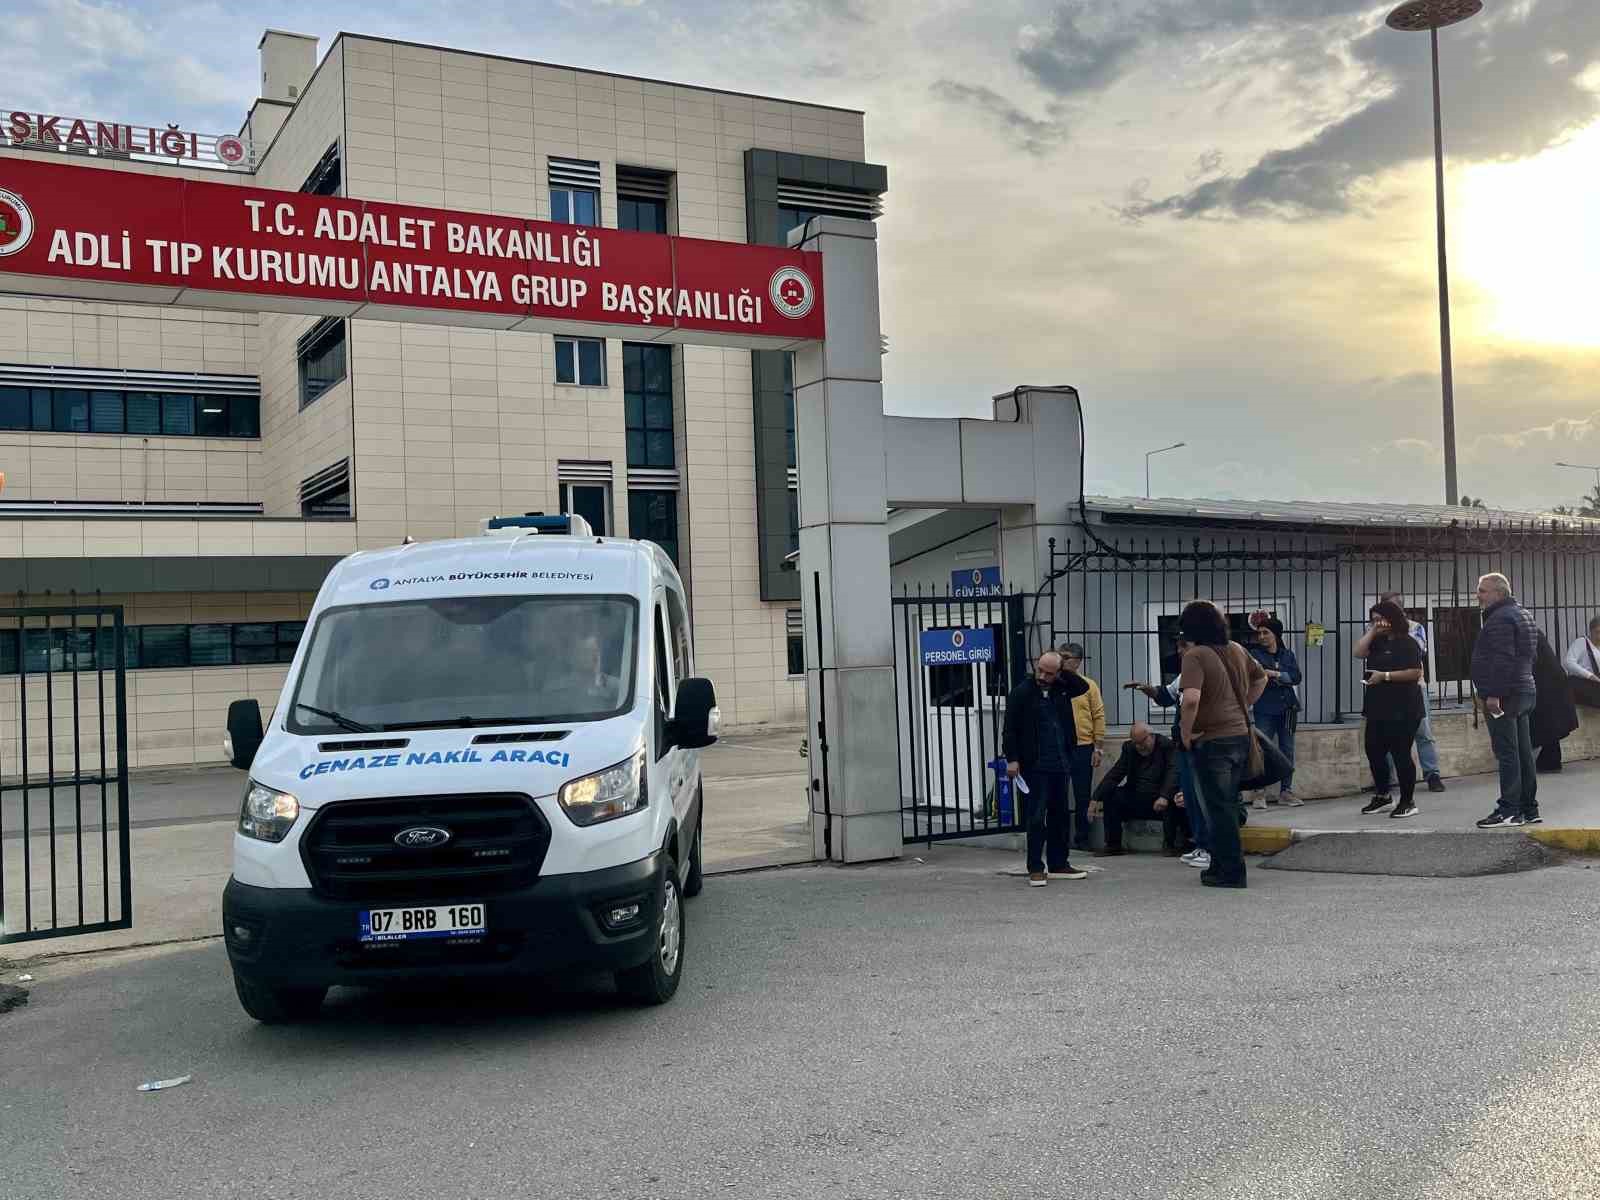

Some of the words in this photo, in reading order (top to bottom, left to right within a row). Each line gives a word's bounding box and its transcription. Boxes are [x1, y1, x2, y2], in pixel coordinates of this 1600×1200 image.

[0, 111, 197, 159] ŞKANLIĞI
[244, 199, 304, 236] T.C.
[314, 207, 436, 250] ADALET
[446, 221, 602, 268] BAKANLIĞI
[47, 229, 131, 271] ADLİ
[145, 238, 202, 275] TIP
[212, 246, 359, 290] KURUMU
[370, 259, 503, 303] ANTALYA
[511, 273, 588, 308] GRUP
[602, 280, 762, 324] BAŞKANLIĞI
[393, 575, 445, 586] ANTALYA
[924, 650, 968, 663] PERSONEL
[969, 646, 992, 660] GİRİŞİ
[299, 755, 399, 780] CENAZE
[406, 748, 483, 766] NAKİL
[490, 750, 570, 768] ARACI
[406, 830, 436, 844] Ford
[371, 912, 393, 932] 07
[402, 909, 437, 930] BRB
[448, 906, 482, 928] 160
